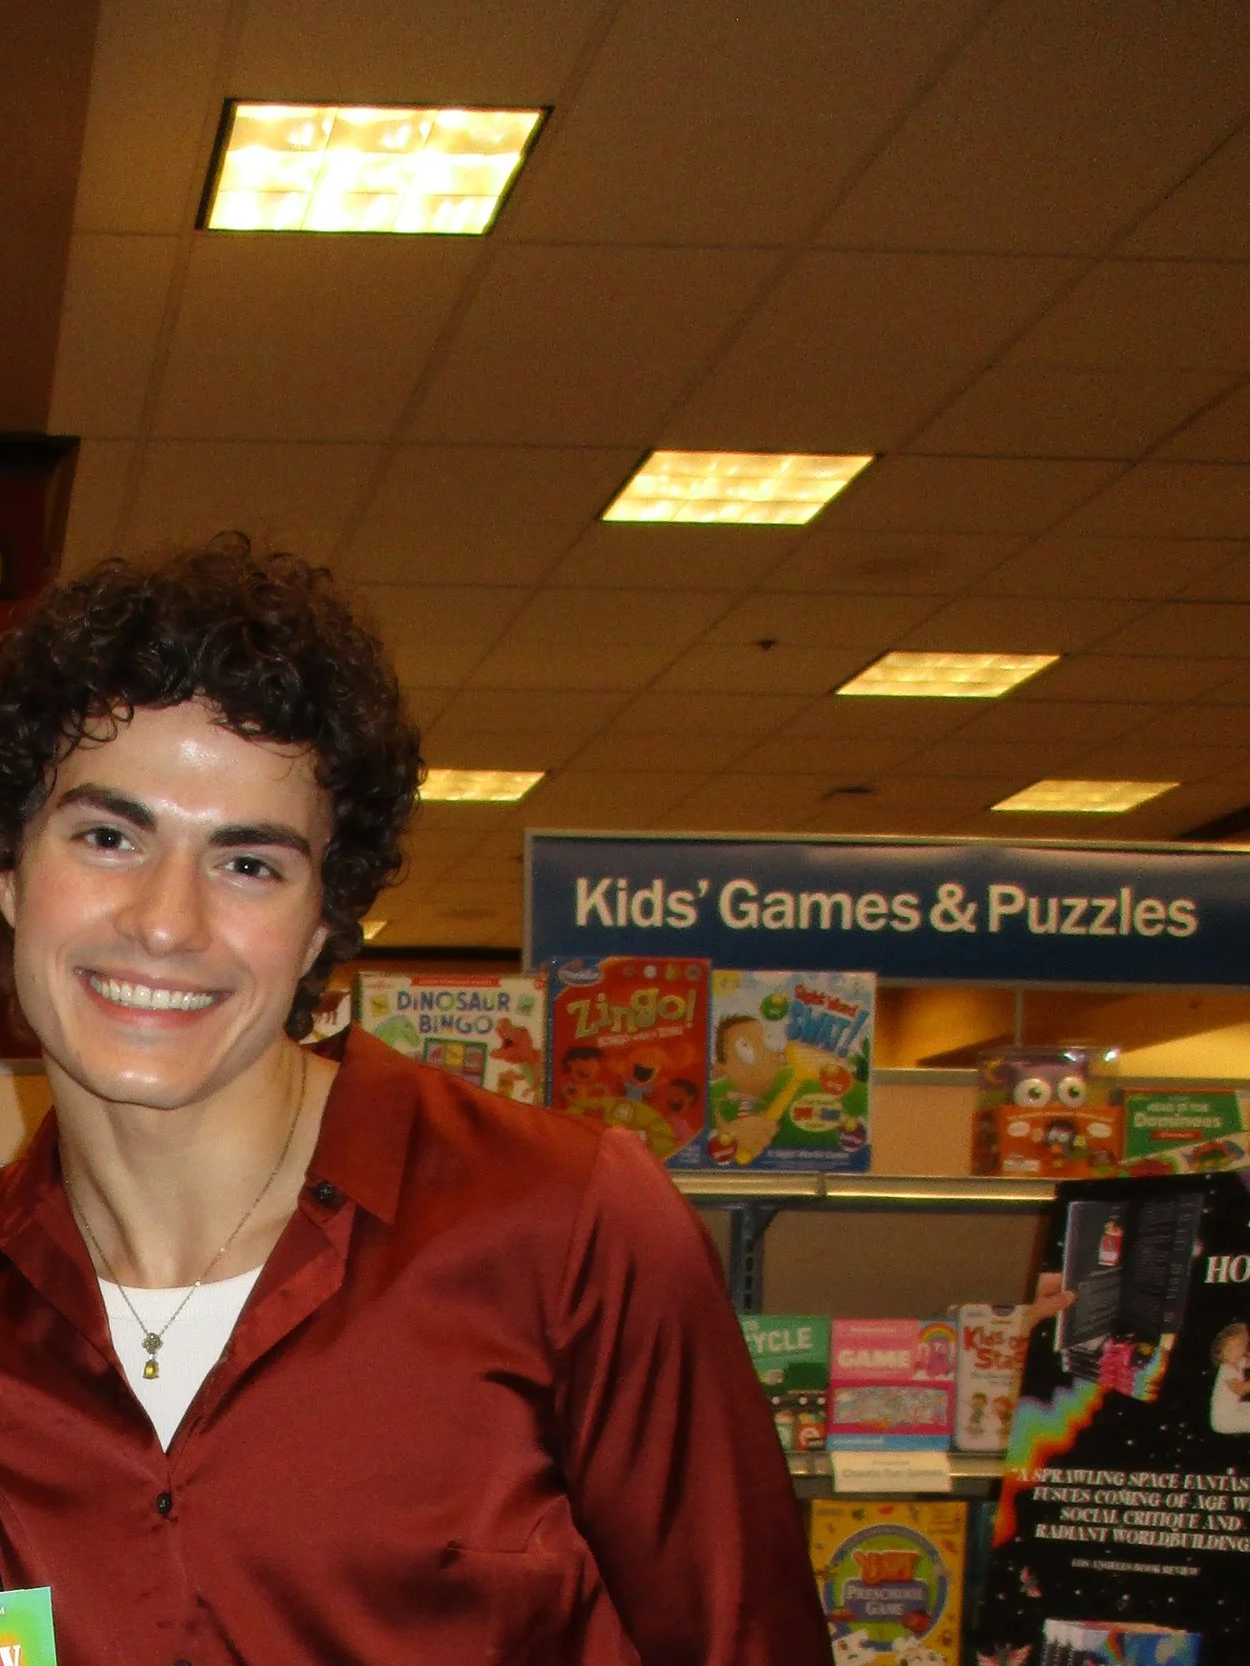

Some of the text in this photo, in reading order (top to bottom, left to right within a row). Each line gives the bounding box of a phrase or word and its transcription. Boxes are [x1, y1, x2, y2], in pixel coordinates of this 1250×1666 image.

[718, 879, 922, 933] Games
[929, 883, 977, 933] &
[988, 884, 1199, 937] Puzzles
[397, 990, 511, 1012] DINOSAUR
[419, 1015, 494, 1034] BINGO
[567, 988, 697, 1041] Zingo!
[837, 1349, 910, 1368] GAME
[1033, 1468, 1126, 1486] SPRAWLING
[1128, 1472, 1180, 1489] SPACE
[1095, 1488, 1162, 1508] COMING
[1166, 1492, 1191, 1508] OF
[1191, 1494, 1229, 1511] AGE
[1060, 1507, 1243, 1533] SOCIAL CRITIQUE AND
[1035, 1523, 1109, 1542] RADIANT
